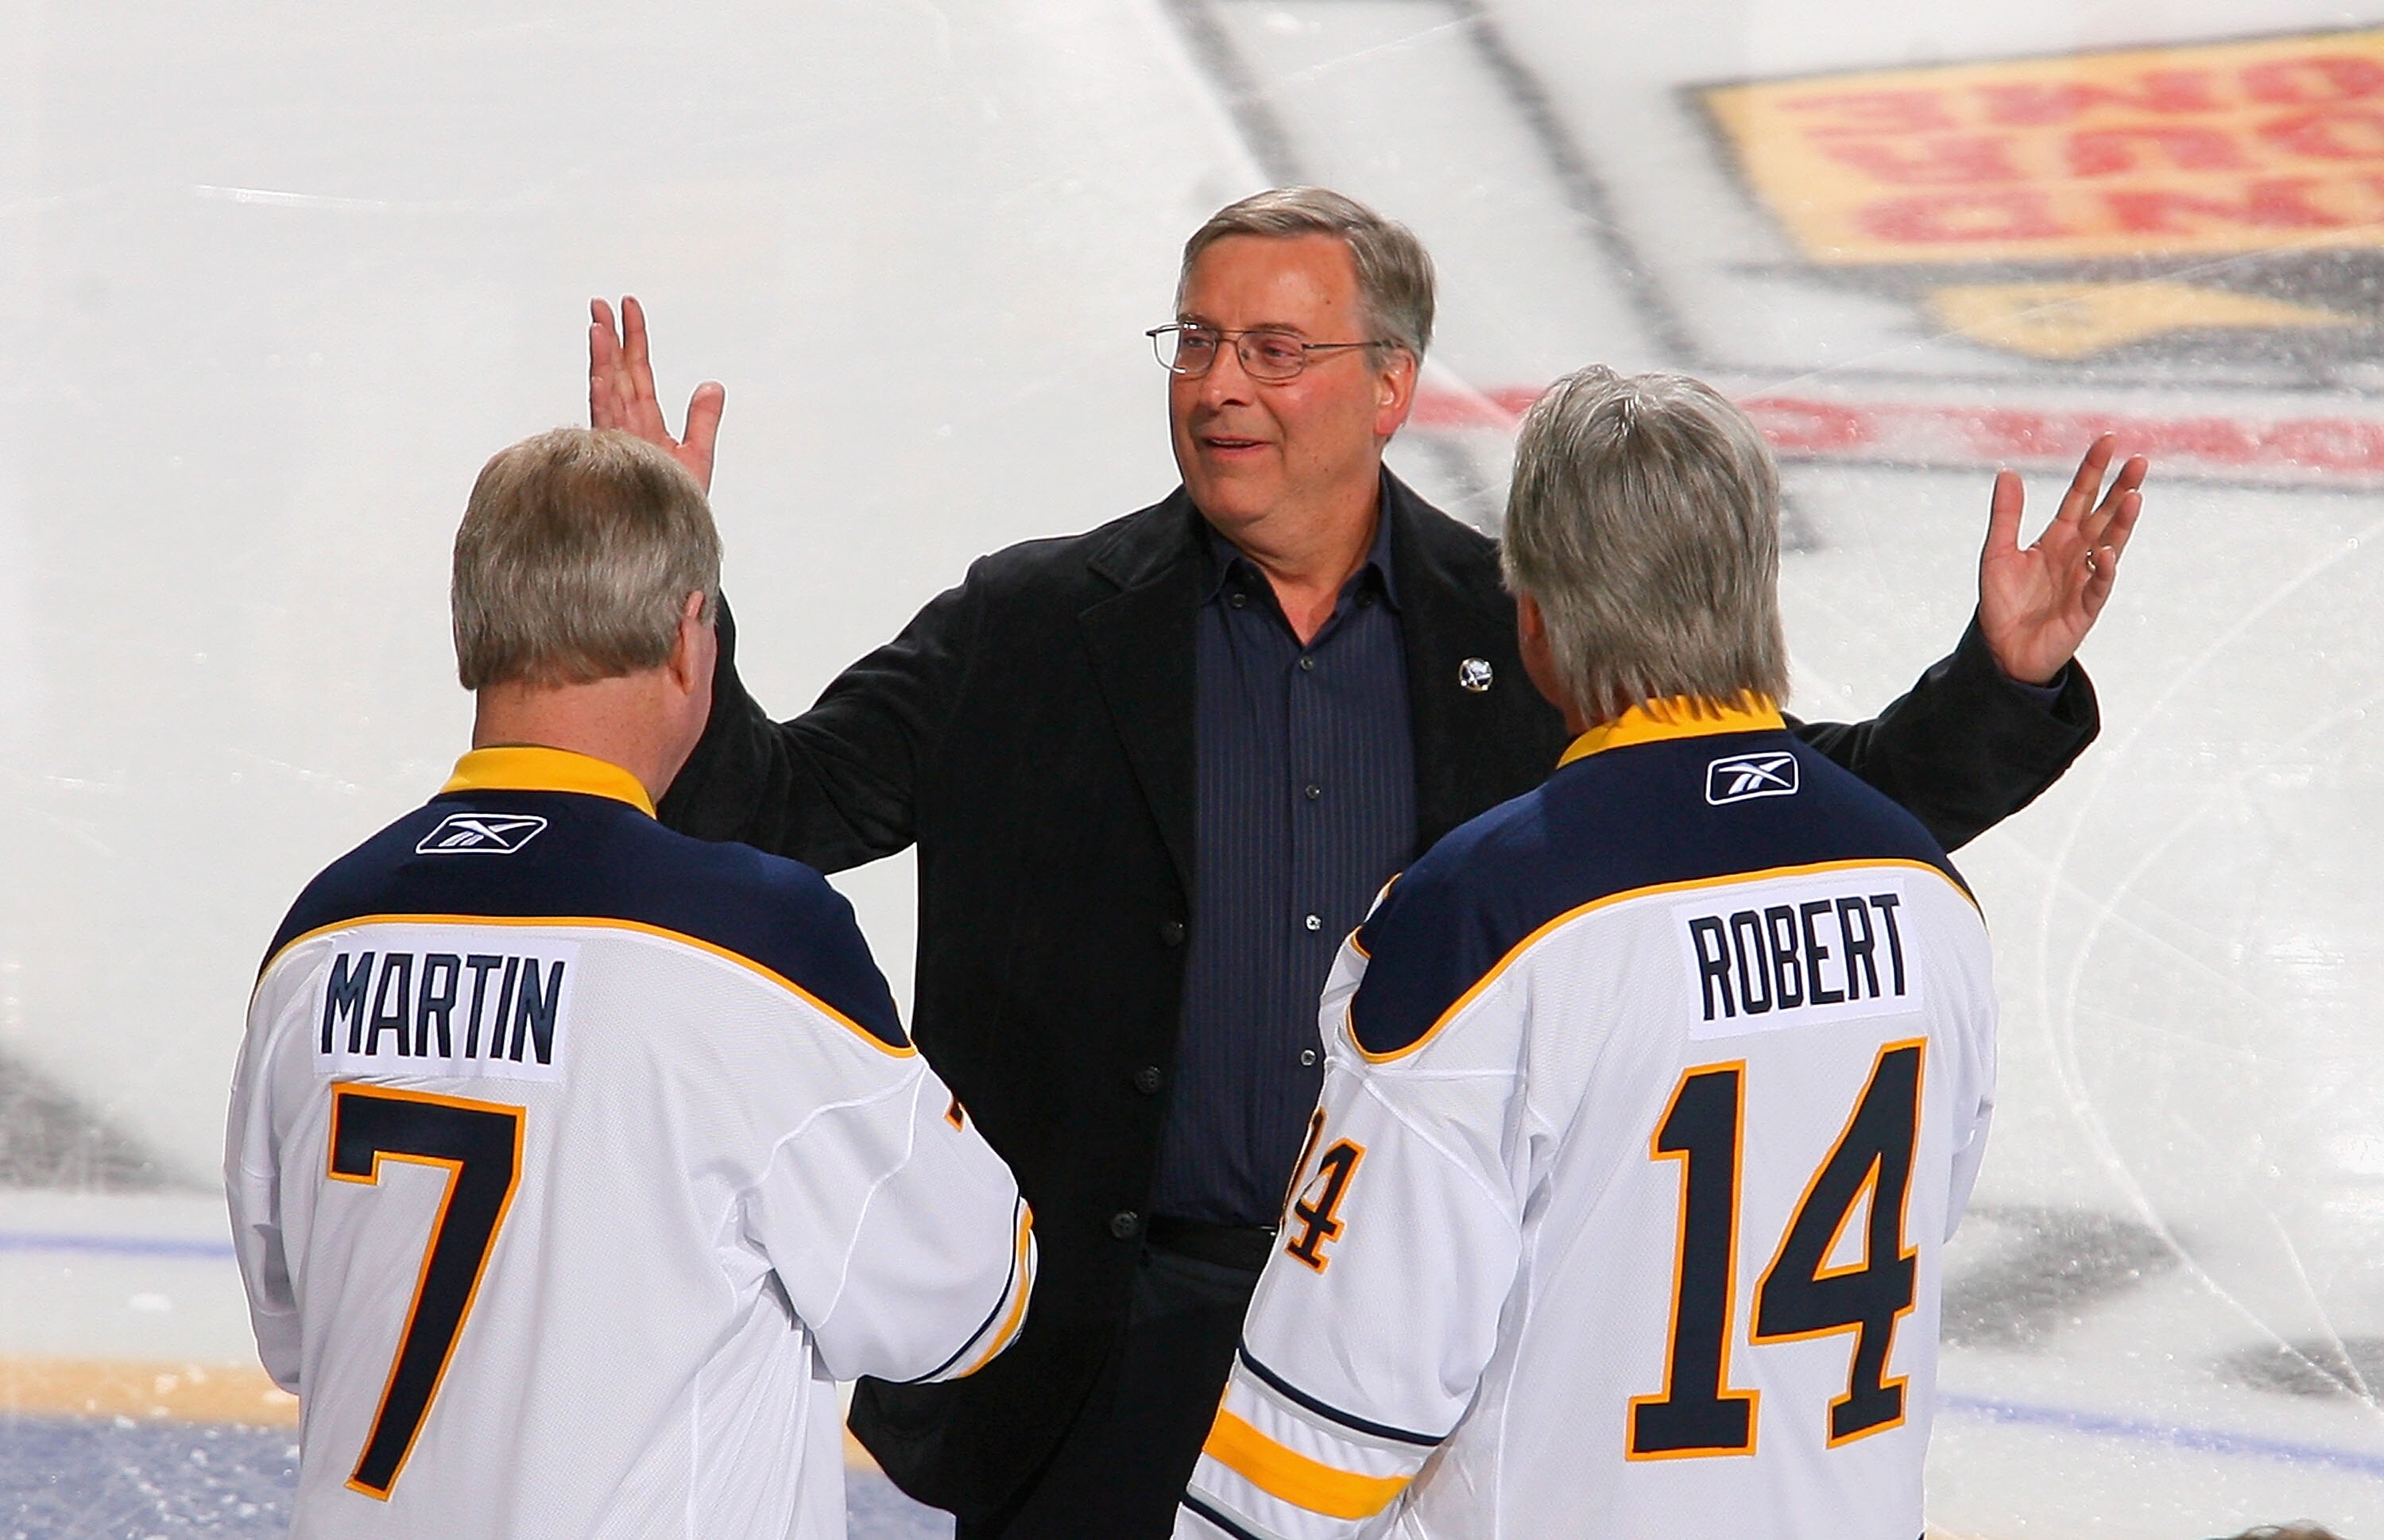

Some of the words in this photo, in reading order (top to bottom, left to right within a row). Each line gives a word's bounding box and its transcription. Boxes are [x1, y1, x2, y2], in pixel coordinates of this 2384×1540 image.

[320, 951, 566, 1065] MARTIN
[1688, 892, 1906, 1022] ROBERT
[327, 1081, 526, 1503] 7
[1625, 1036, 1928, 1461] 14
